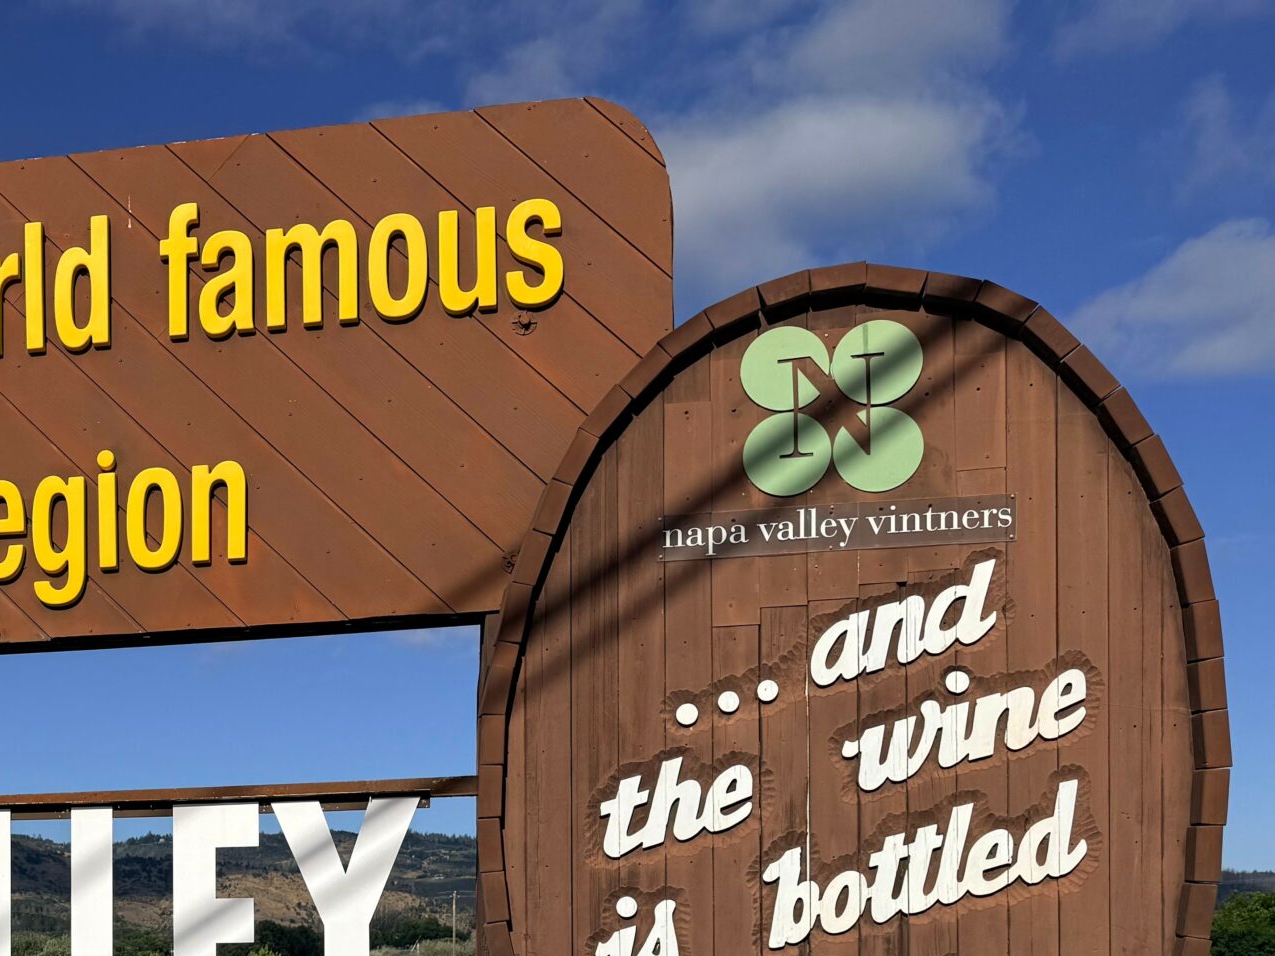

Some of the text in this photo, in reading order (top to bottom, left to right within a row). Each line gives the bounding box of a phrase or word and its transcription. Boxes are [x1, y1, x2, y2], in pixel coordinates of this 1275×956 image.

[158, 198, 565, 341] famous
[662, 504, 1013, 556] napa valley vintners
[599, 669, 1087, 859] the wine
[761, 778, 1088, 949] bottled
